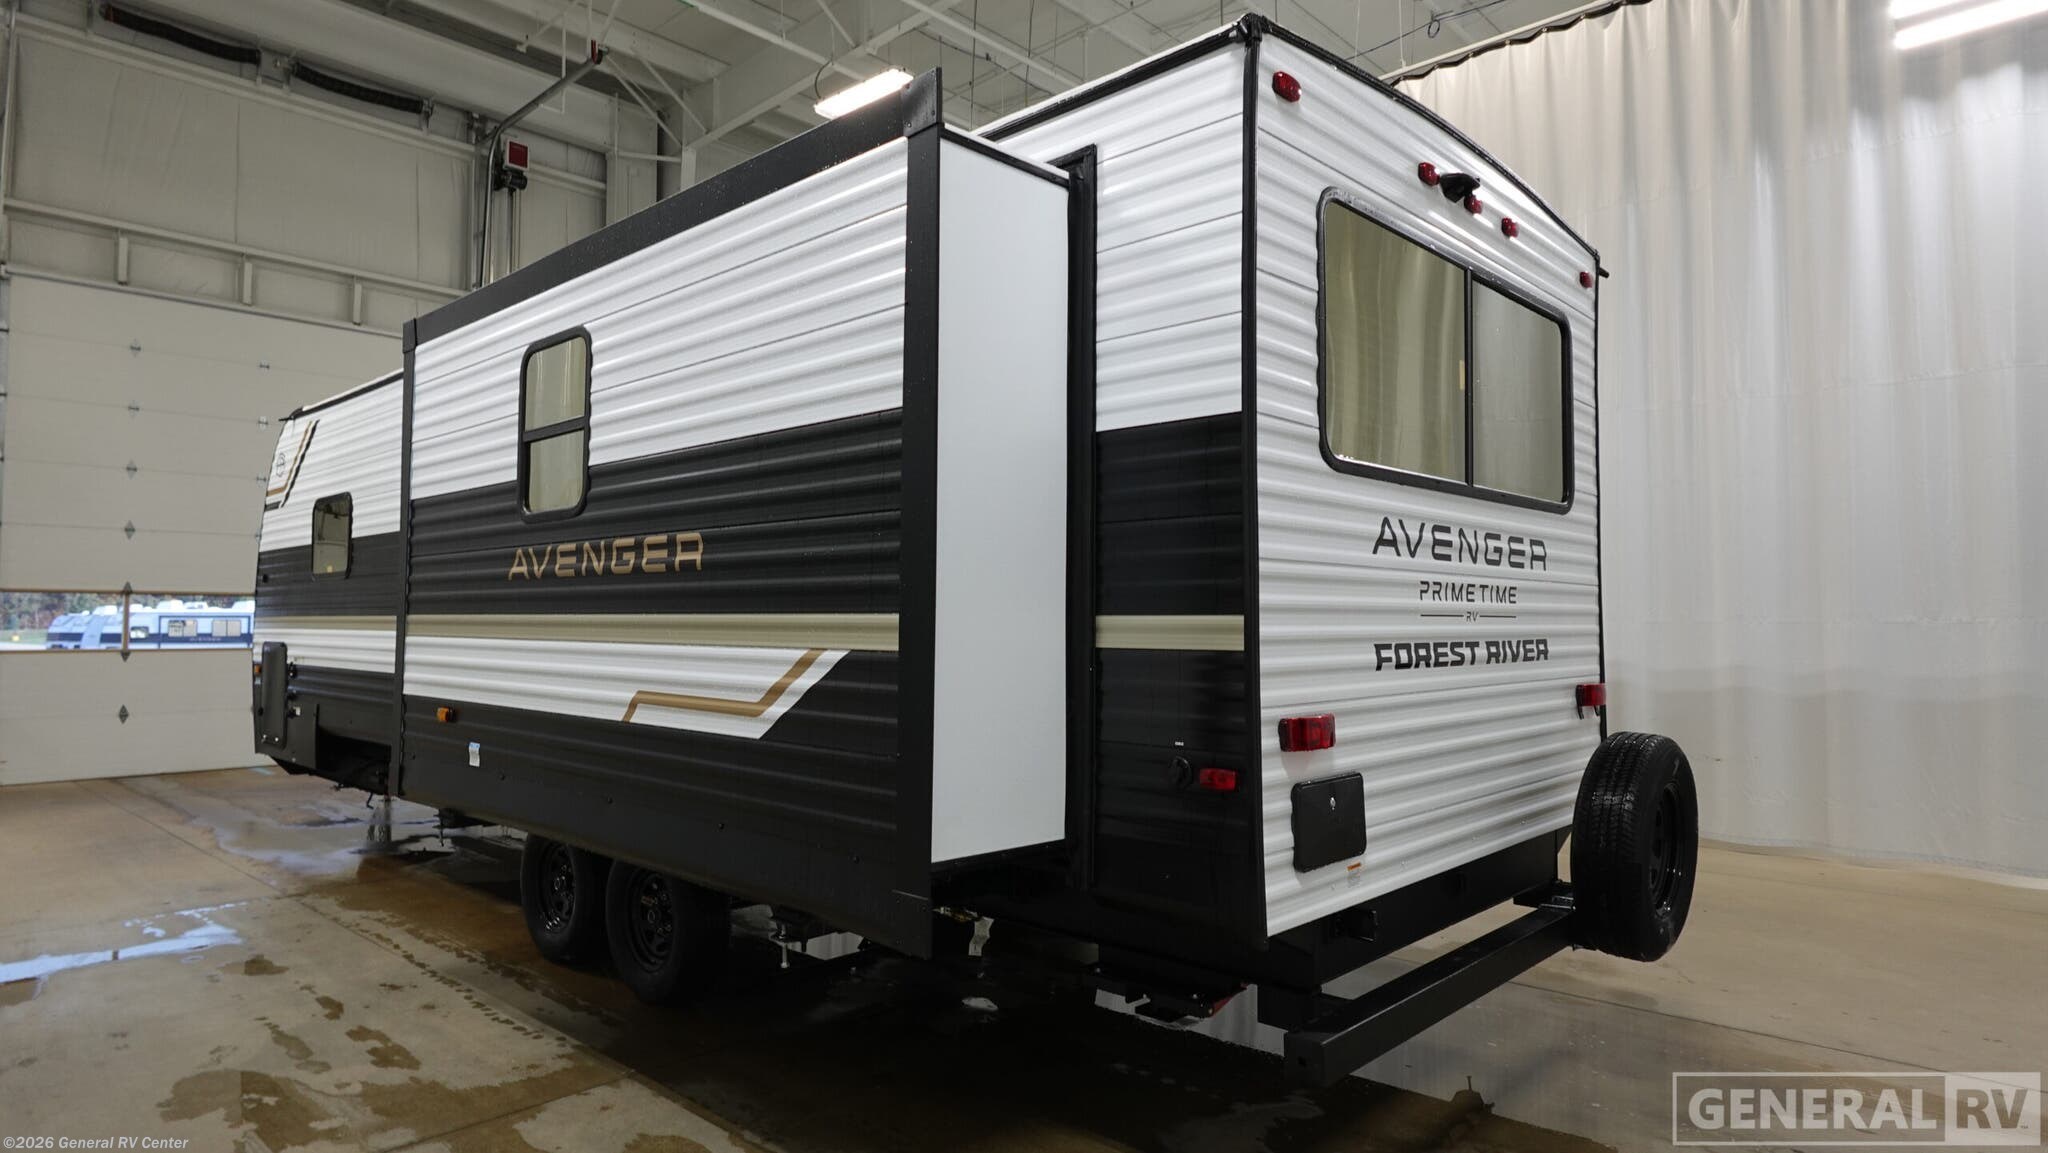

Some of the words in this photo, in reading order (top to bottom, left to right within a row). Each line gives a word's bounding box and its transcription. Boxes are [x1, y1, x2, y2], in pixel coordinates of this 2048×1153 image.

[508, 532, 704, 581] AVENGER
[1372, 516, 1547, 572] AVENGER
[1466, 611, 1479, 622] RV
[1373, 641, 1480, 672] FOREST
[1485, 638, 1550, 665] RIVER
